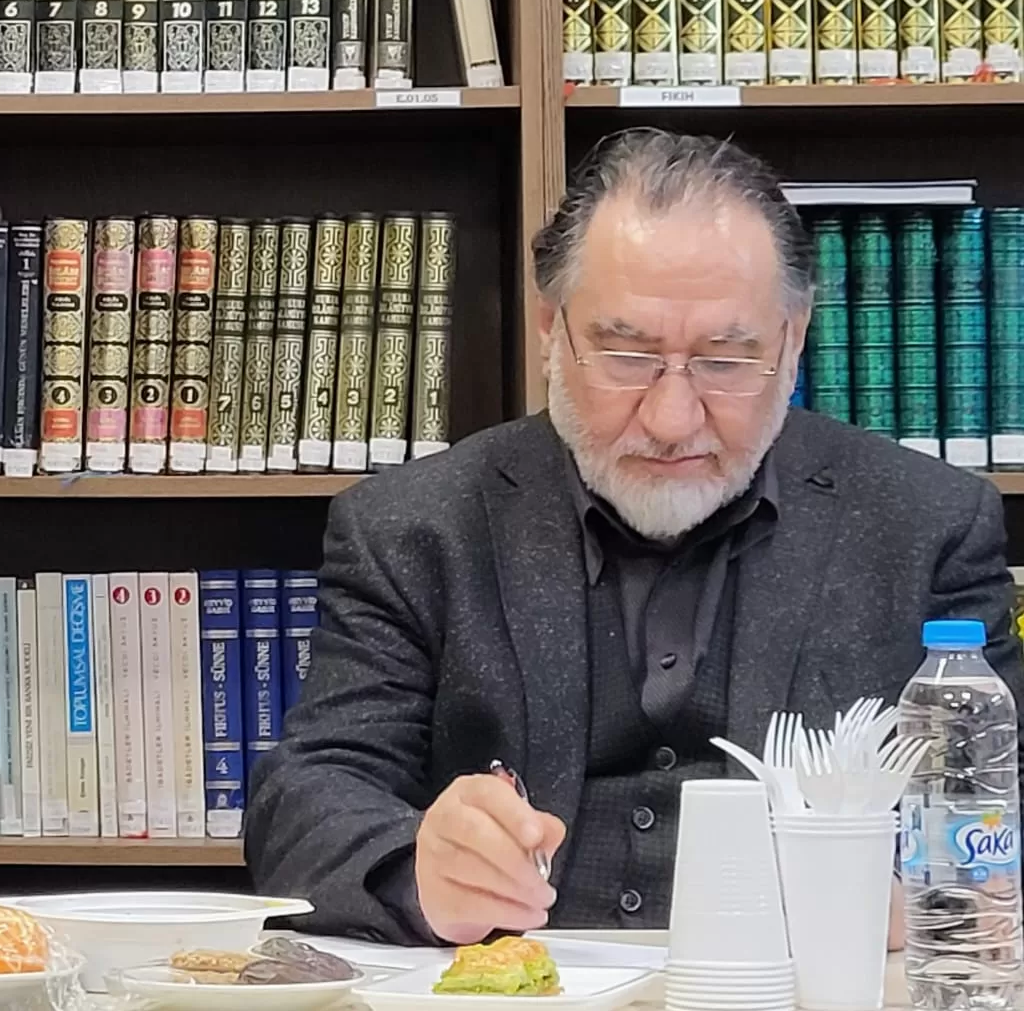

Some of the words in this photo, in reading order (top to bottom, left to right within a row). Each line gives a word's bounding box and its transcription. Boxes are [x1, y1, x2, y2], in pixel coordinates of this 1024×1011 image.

[5, 2, 18, 17] 6
[49, 2, 63, 17] 7
[95, 1, 108, 17] 8
[132, 4, 145, 20] 9
[172, 2, 192, 18] 10
[218, 1, 233, 17] 11
[259, 0, 277, 16] 12
[301, 0, 320, 15] 13
[661, 91, 695, 101] FIKIH
[23, 258, 30, 270] 1
[57, 390, 65, 403] 4
[103, 390, 112, 403] 3
[146, 388, 155, 401] 2
[187, 388, 193, 402] 1
[280, 395, 292, 409] 5
[318, 390, 328, 404] 4
[348, 391, 359, 404] 3
[385, 389, 396, 402] 2
[430, 391, 437, 404] 1
[218, 396, 231, 411] 7
[252, 396, 261, 410] 6
[211, 642, 226, 682] SÜNNE
[255, 642, 270, 682] SÜNNE
[72, 645, 89, 726] TOPLUMSAL
[217, 757, 228, 774] 4
[964, 826, 1014, 866] Saka
